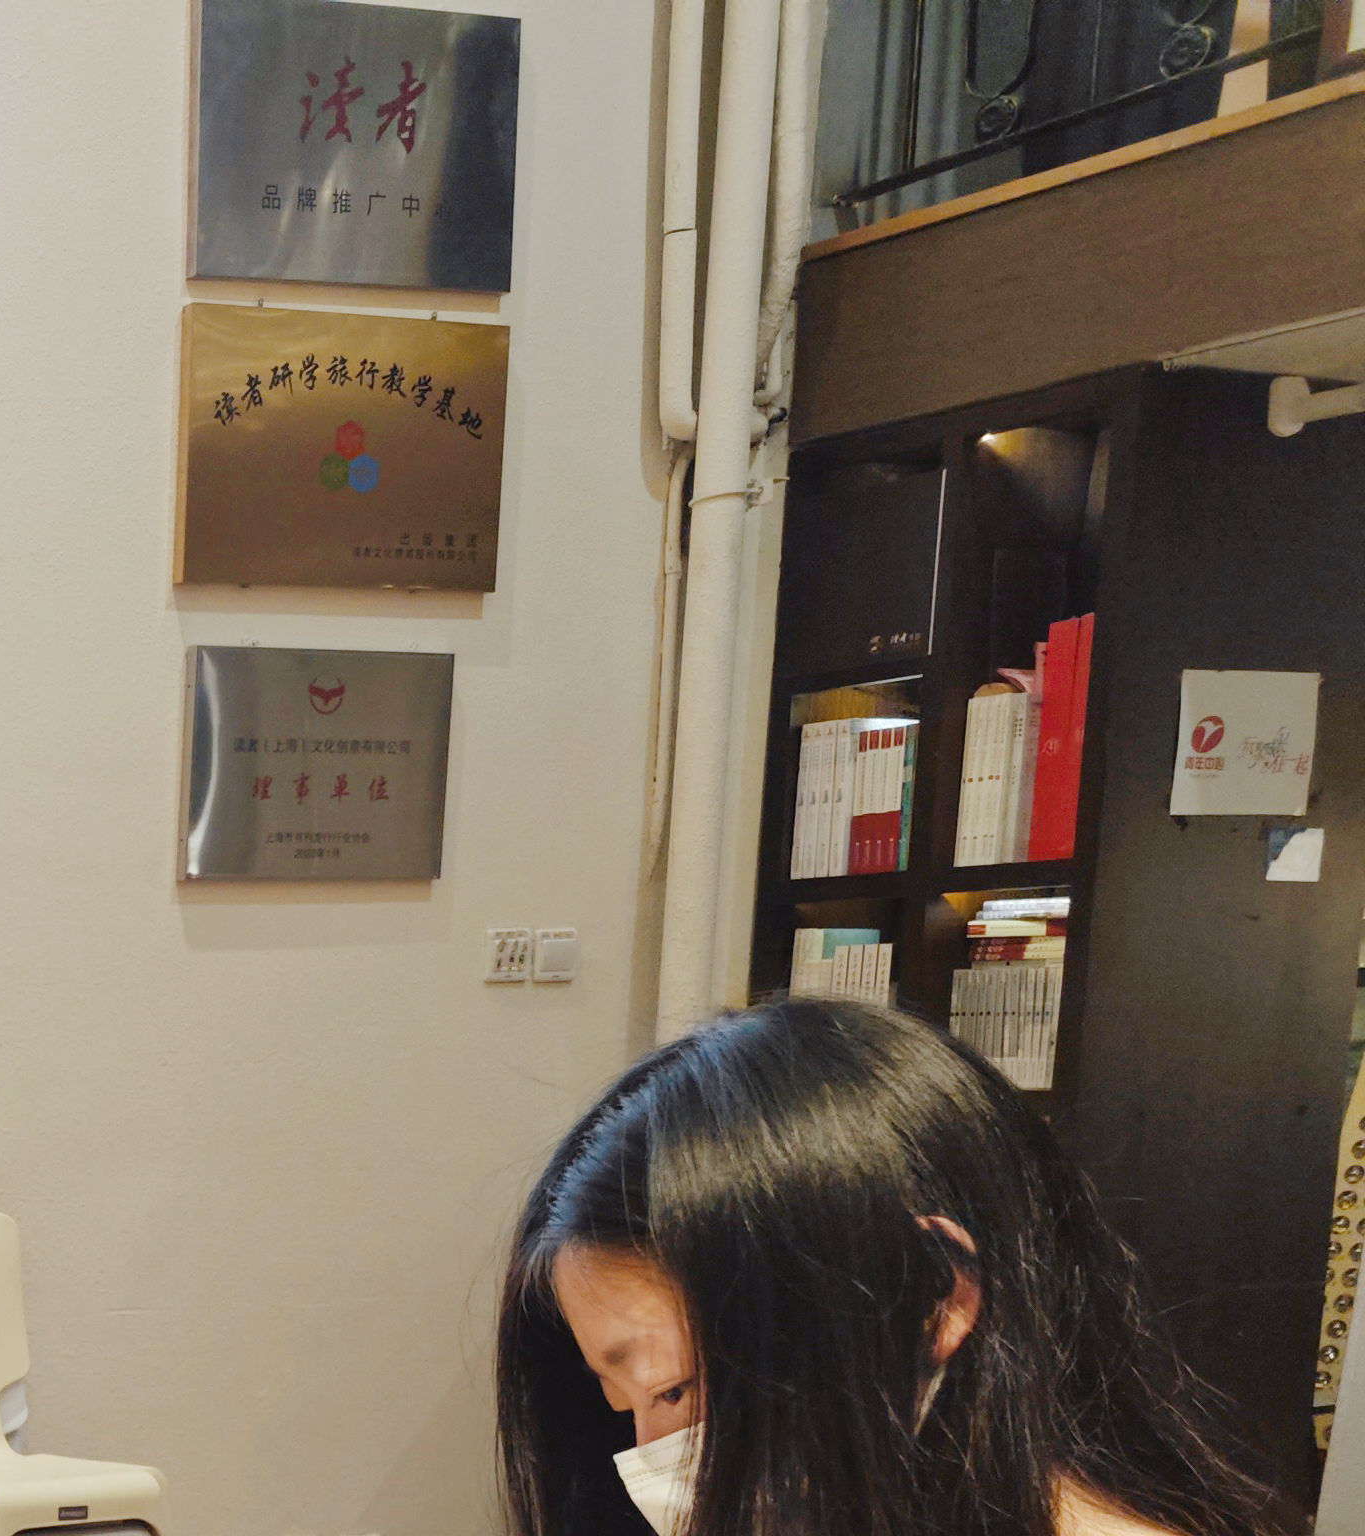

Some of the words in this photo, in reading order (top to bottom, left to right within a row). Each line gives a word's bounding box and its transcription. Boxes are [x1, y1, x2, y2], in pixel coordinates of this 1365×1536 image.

[299, 56, 426, 154] 读者
[214, 354, 482, 440] 读者研学旅行教学基地
[252, 772, 389, 805] 理事单位
